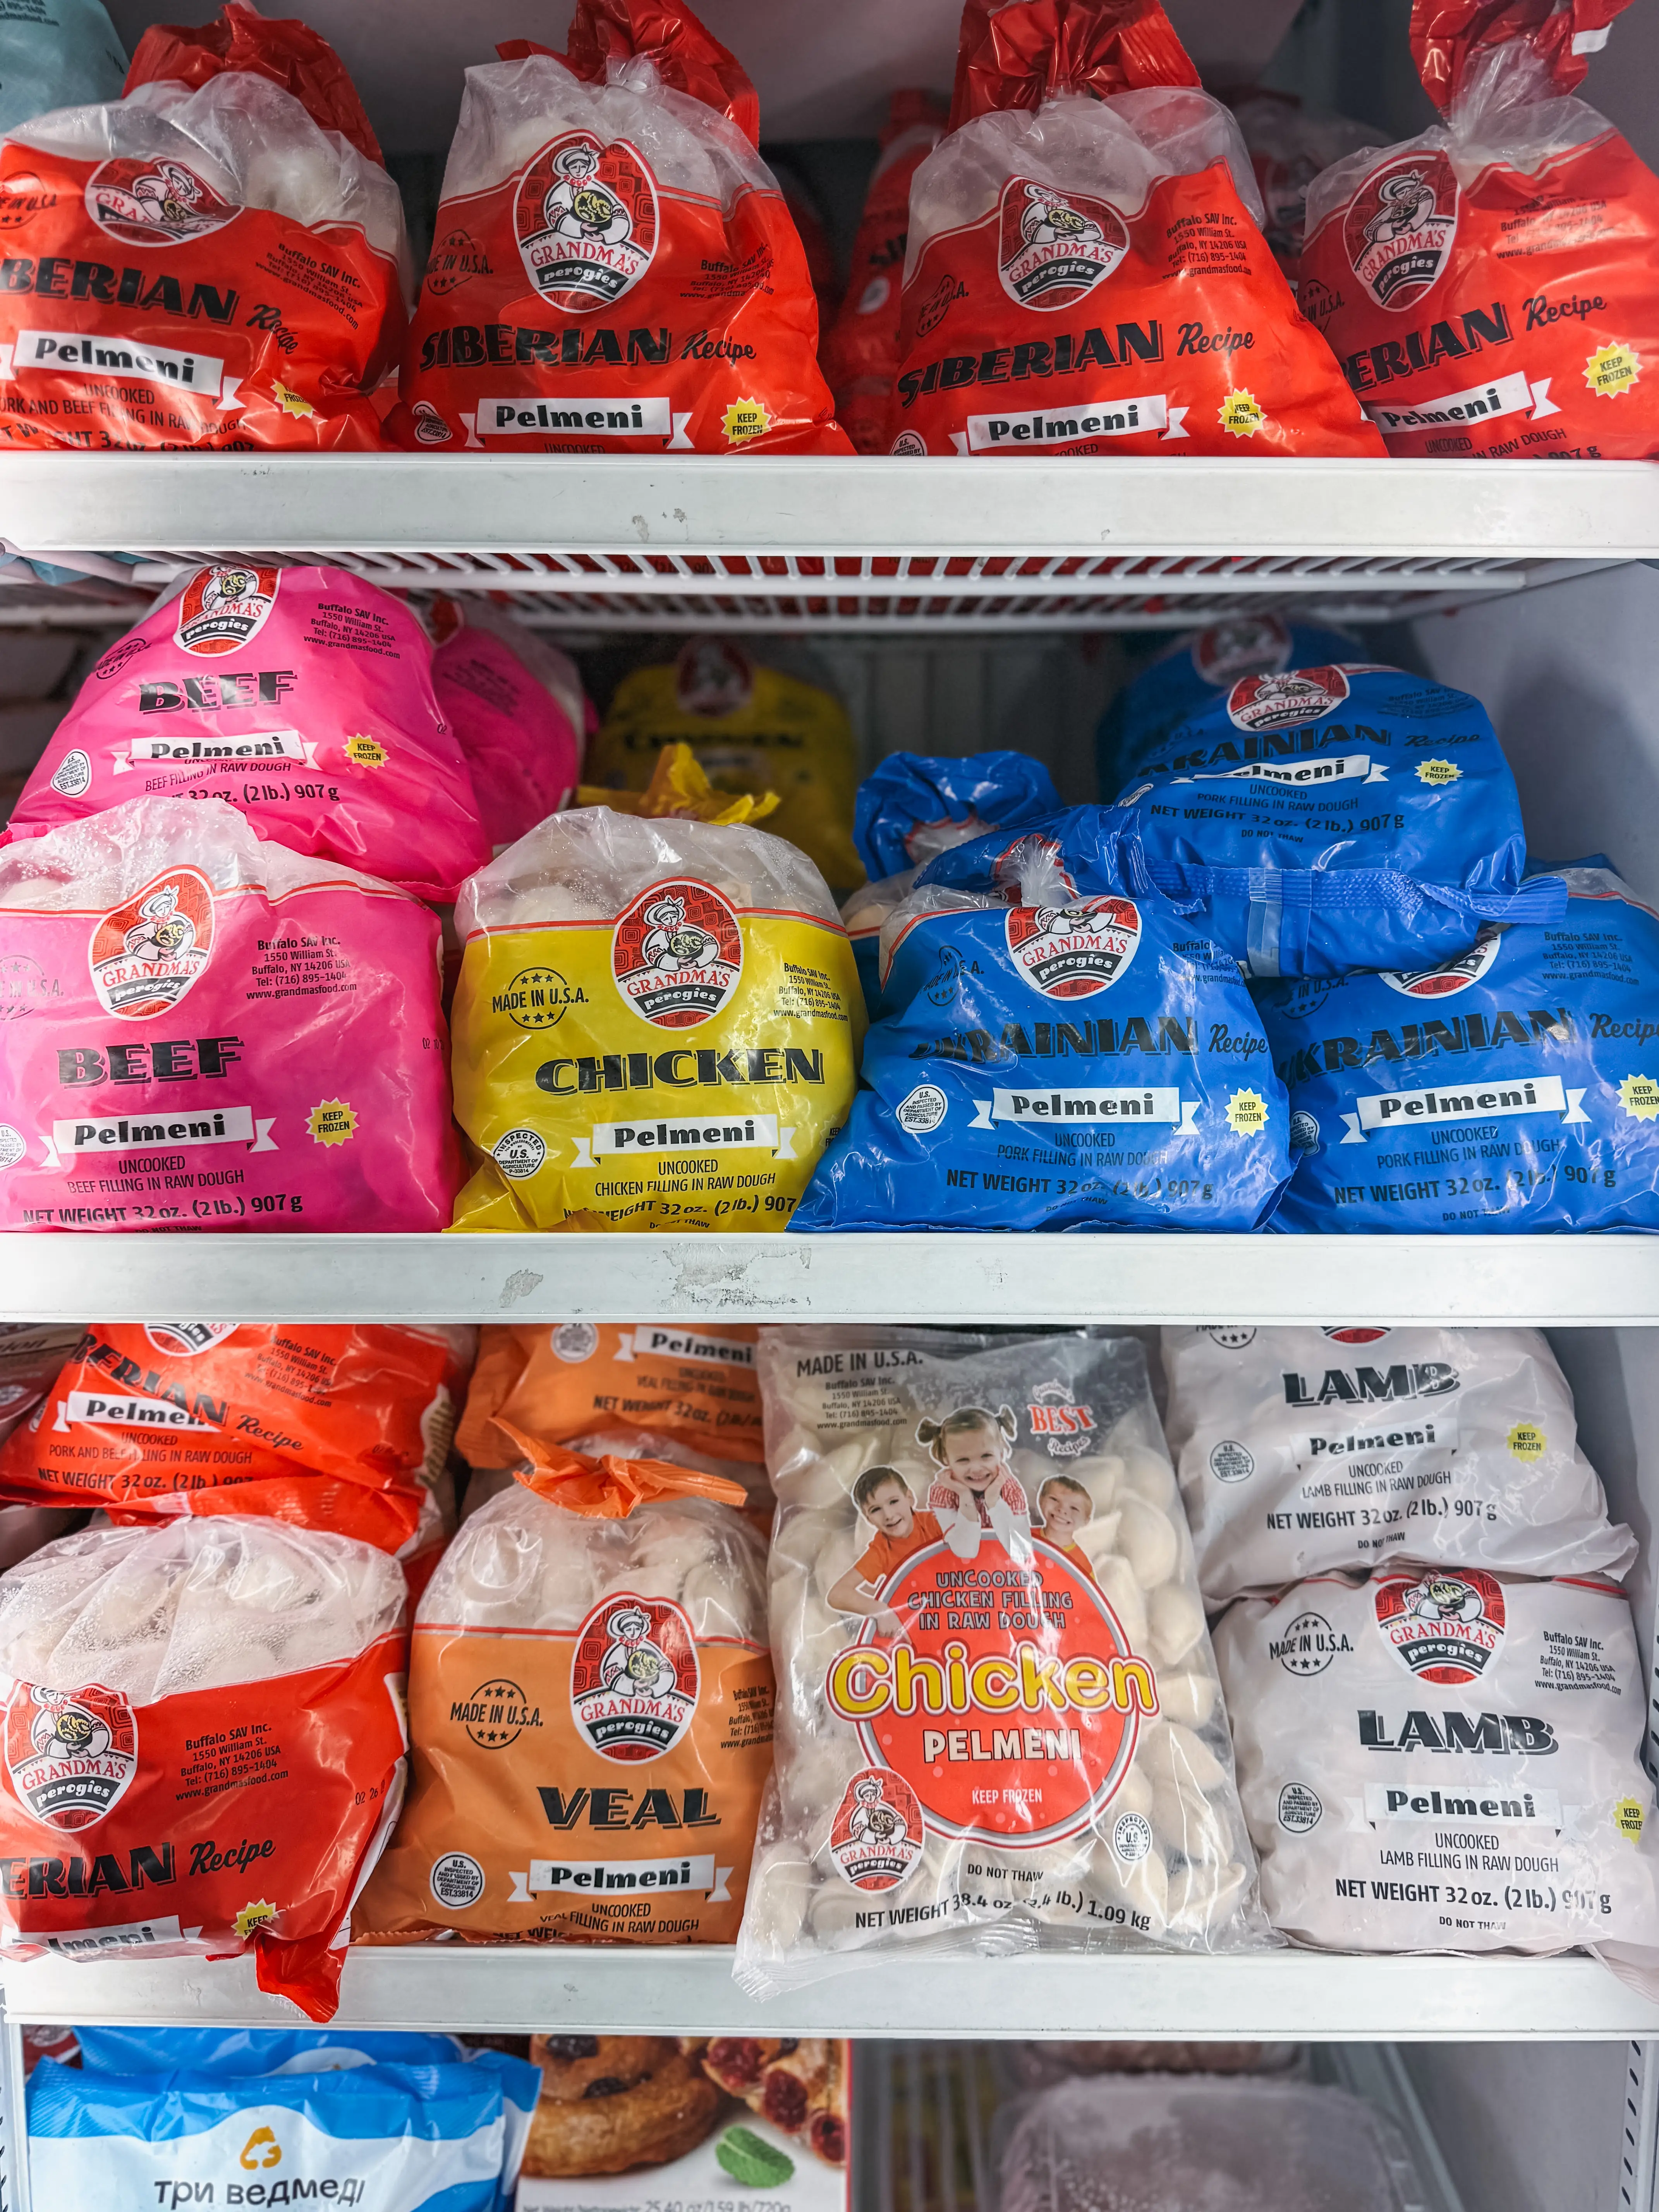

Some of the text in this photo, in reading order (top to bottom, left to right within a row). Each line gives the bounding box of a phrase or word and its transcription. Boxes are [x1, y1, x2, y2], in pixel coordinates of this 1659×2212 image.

[531, 242, 639, 275] GRANDMA'S
[1008, 242, 1113, 283] GRANDMA'S
[1363, 230, 1446, 282] GRANDMA'S
[1522, 295, 1607, 331] Recipe
[420, 325, 756, 371] SIBERIAN Recipe
[35, 338, 195, 383] Pelmeni
[897, 320, 1255, 408] SIBERIAN Recipe
[1600, 356, 1622, 371] KEEP
[1597, 366, 1632, 386] FROZEN
[496, 405, 643, 428] Pelmeni
[737, 414, 757, 423] KEEP
[1384, 388, 1502, 427] Pelmeni
[732, 425, 763, 435] FROZEN
[989, 404, 1139, 441] Pelmeni
[318, 603, 389, 625] Buffalo SAV Inc.
[323, 612, 342, 622] 1550
[345, 616, 372, 630] William
[311, 618, 340, 632] Buffalo,
[355, 629, 379, 639] 14206
[314, 627, 392, 647] Tel: (716) 895-1404
[304, 636, 400, 659] www.grandmasfood.com
[139, 670, 299, 714] BEEF
[151, 736, 283, 758] Pelmeni
[353, 751, 381, 762] FROZEN
[357, 742, 376, 752] KEEP
[1430, 766, 1449, 774] KEEP
[1249, 785, 1307, 800] UNCOOKED
[1022, 935, 1128, 967] GRANDMA'S
[103, 961, 201, 986] GRANDMA'S
[627, 970, 730, 996] GRANDMA'S
[492, 987, 589, 1013] MADE IN U.S.A.
[1209, 1024, 1267, 1061] Recipe
[57, 1035, 245, 1089] BEEF
[535, 1048, 824, 1096] CHICKEN
[1379, 1083, 1537, 1118] Pelmeni
[1633, 1085, 1652, 1096] KEEP
[322, 1110, 343, 1121] KEEP
[1012, 1092, 1154, 1116] Pelmeni
[1238, 1102, 1255, 1112] KEEP
[318, 1120, 350, 1133] FROZEN
[1235, 1112, 1262, 1122] FROZEN
[74, 1114, 226, 1145] Pelmeni
[614, 1120, 755, 1148] Pelmeni
[1055, 1132, 1115, 1148] UNCOOKED
[498, 1133, 541, 1152] INSPECTED
[510, 1149, 529, 1159] U.S.
[118, 1157, 186, 1174] UNCOOKED
[658, 1160, 718, 1176] UNCOOKED
[68, 1170, 245, 1193] BEEF FILLING IN RAW DOUGH
[595, 1173, 775, 1197] CHICKEN FILLING IN RAW DOUGH
[946, 1168, 1051, 1193] NET WEIGHT
[251, 1194, 286, 1213] 907
[797, 1351, 923, 1377] MADE IN U.S.A.
[1282, 1362, 1461, 1408] LAMB
[1029, 1406, 1094, 1432] BEST
[236, 1413, 304, 1451] Recipe
[1310, 1423, 1436, 1456] Pelmeni
[1517, 1431, 1536, 1442] KEEP
[1513, 1442, 1541, 1452] FROZEN
[1348, 1461, 1403, 1478] UNCOOKED
[936, 1569, 1043, 1587] UNCOOKED
[907, 1591, 1073, 1610] CHICKEN FILLING
[920, 1612, 1066, 1631] IN RAW DOUGH
[1390, 1622, 1496, 1649] GRANDMA'S
[1544, 1631, 1604, 1650] Buffalo SAV Inc.
[1269, 1637, 1354, 1660] MADE IN U.S.A.
[1550, 1645, 1600, 1661] 1550 William St.
[1540, 1655, 1563, 1669] Buffalo,
[1566, 1659, 1573, 1668] NY
[1576, 1661, 1599, 1671] 14206
[1542, 1668, 1615, 1681] Tel: (716) 895-1404
[830, 1642, 1157, 1715] Chicken
[1535, 1680, 1621, 1695] www.grandmasfood.com
[450, 1702, 543, 1726] MADE IN U.S.A.
[581, 1697, 685, 1722] GRANDMA'S
[1357, 1709, 1559, 1755] LAMB
[923, 1730, 1081, 1762] PELMENI
[22, 1759, 126, 1789] GRANDMA'S
[536, 1786, 721, 1830] VEAL
[972, 1788, 1042, 1805] KEEP FROZEN
[1387, 1790, 1536, 1818] Pelmeni
[1435, 1833, 1499, 1850] UNCOOKED
[189, 1837, 276, 1877] Recipe
[840, 1843, 914, 1865] GRANDMA'S
[1380, 1851, 1559, 1872] LAMB FILLING IN RAW DOUGH
[551, 1861, 690, 1888] Pelmeni
[967, 1863, 1043, 1882] DO NOT THAW
[1336, 1879, 1499, 1906] NET WEIGHT 32 oz.
[591, 1902, 651, 1917] UNCOOKED
[1088, 1900, 1152, 1932] 1.09 kg
[154, 2178, 365, 2210] три ведмеді
